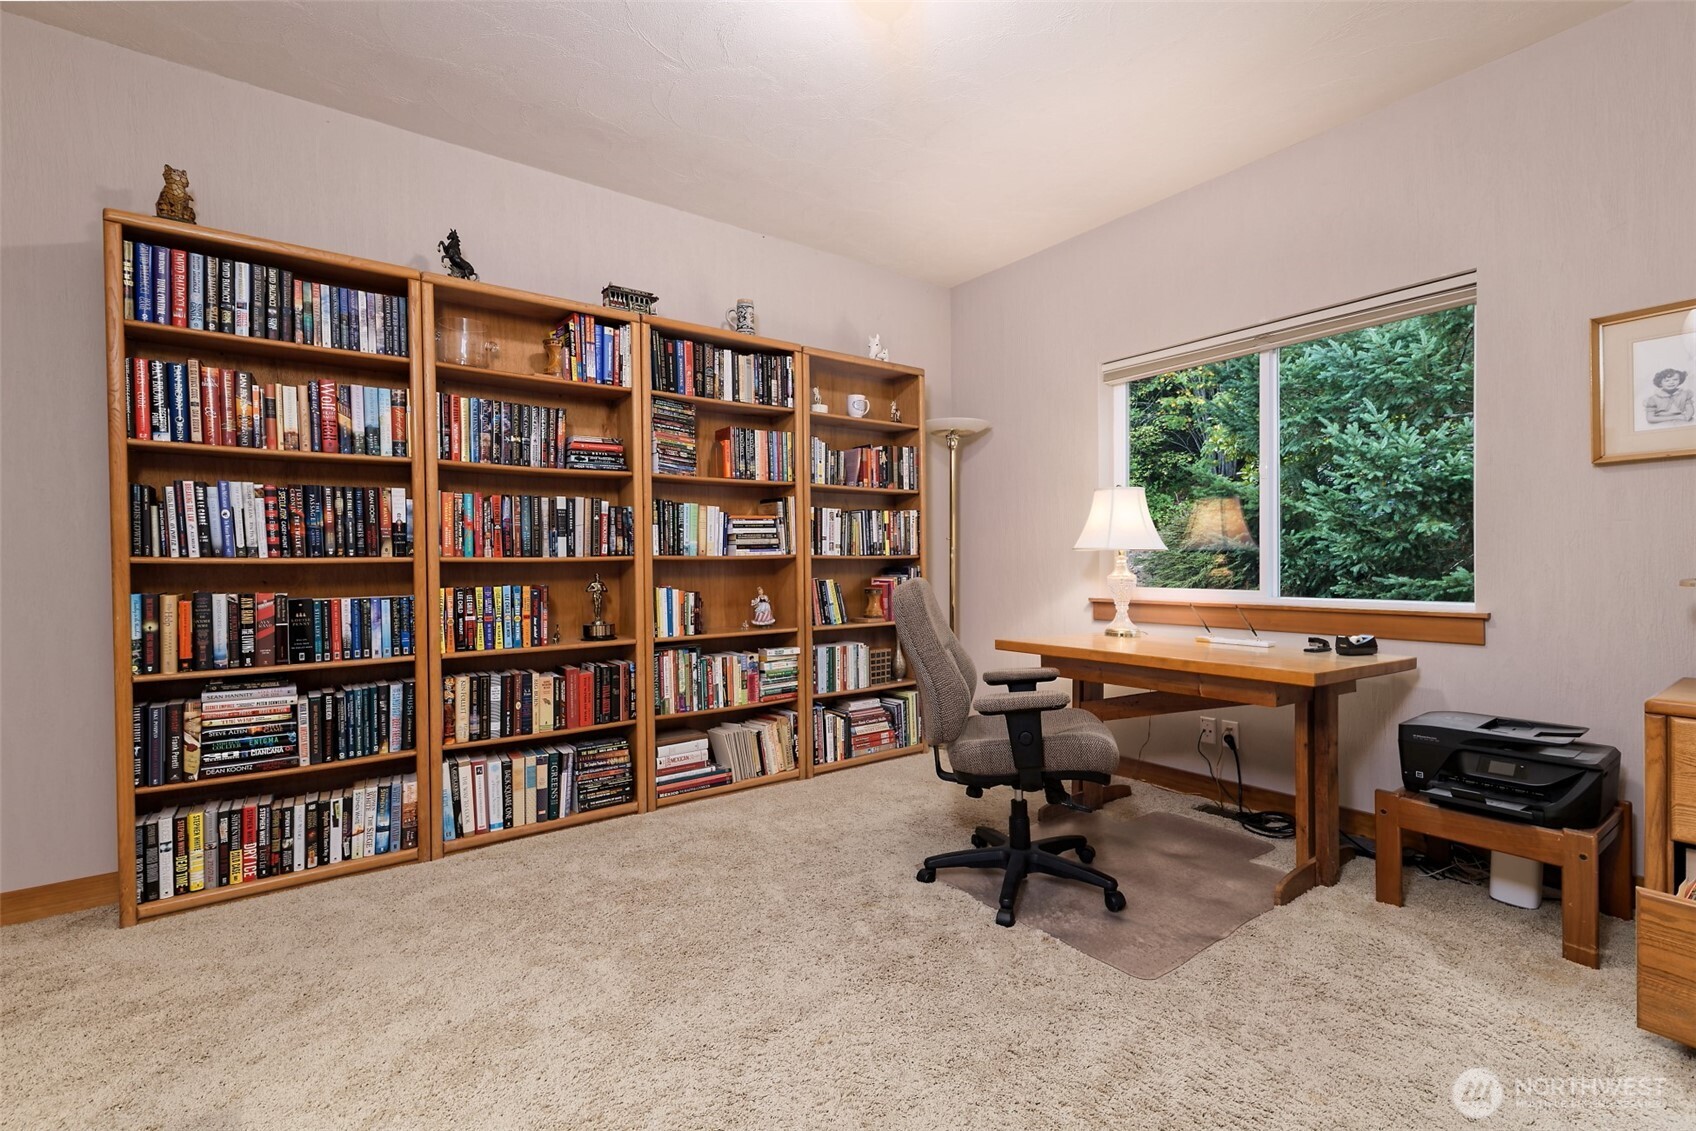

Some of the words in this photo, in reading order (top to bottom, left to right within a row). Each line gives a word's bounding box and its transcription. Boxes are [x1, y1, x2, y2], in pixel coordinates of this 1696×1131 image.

[174, 252, 185, 273] DAVID
[222, 262, 231, 278] DAVID
[268, 269, 276, 284] DAVID
[174, 275, 185, 306] BALDACCI
[207, 276, 217, 304] BALDACCI
[222, 279, 231, 303] BALDACCI
[268, 284, 277, 307] BALDACCI
[152, 362, 163, 379] DAN
[174, 365, 183, 382] DAN
[239, 373, 247, 387] DAN
[153, 381, 164, 407] BROWN
[320, 382, 336, 412] Wolf
[321, 419, 336, 441] Hall
[196, 486, 204, 500] JOHN
[134, 520, 142, 546] LOWRY
[241, 609, 254, 625] RAND
[205, 768, 225, 776] DEAN
[550, 765, 559, 799] GREENS
[177, 820, 185, 841] STEPHEN
[193, 815, 201, 835] STEPHEN
[366, 827, 374, 848] SIEGE
[244, 843, 257, 860] DRY
[176, 856, 188, 873] DEAD
[232, 864, 241, 875] CASE
[244, 862, 257, 878] ICE
[176, 872, 188, 889] TIME
